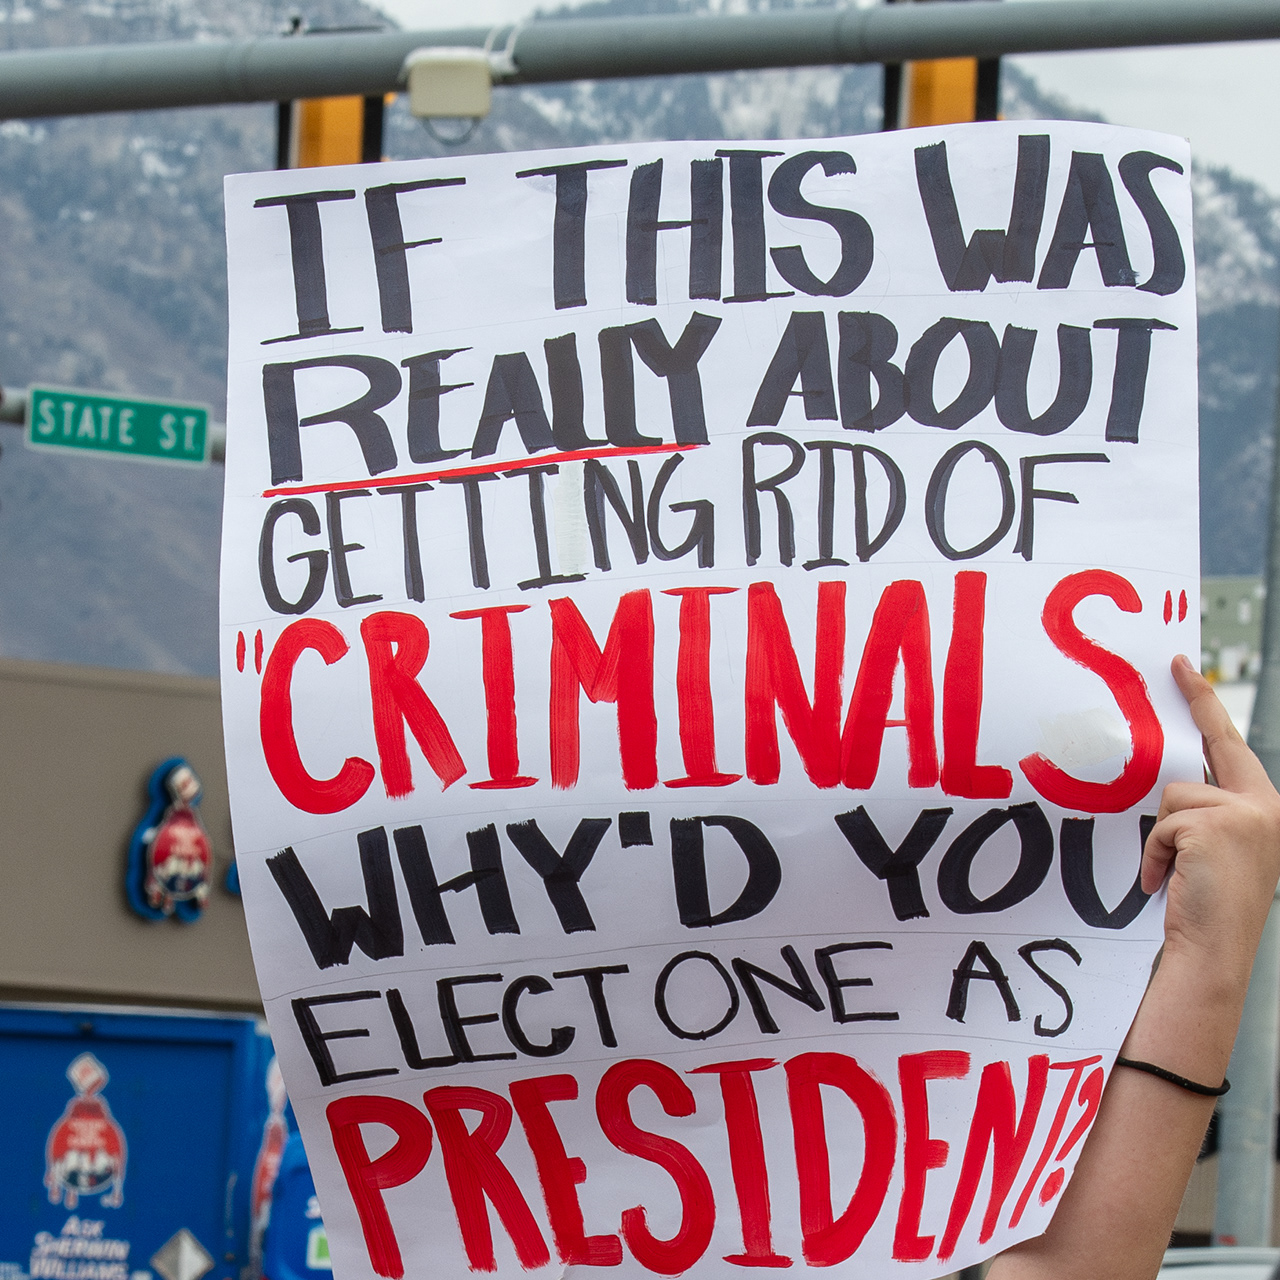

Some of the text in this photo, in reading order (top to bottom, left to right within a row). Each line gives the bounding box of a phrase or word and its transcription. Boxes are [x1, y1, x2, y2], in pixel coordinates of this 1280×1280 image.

[254, 135, 1185, 344] IF THIS WAS
[37, 398, 136, 446] STATE
[263, 311, 1178, 486] REALLY ABOUT
[260, 431, 1110, 614] GETTING RID OF
[236, 569, 1187, 814] "CRIMINALS"
[266, 801, 1160, 970] WHY'D YOU
[291, 938, 1082, 1088] ELECT ONE AS
[326, 1049, 1105, 1280] PRESIDENT?
